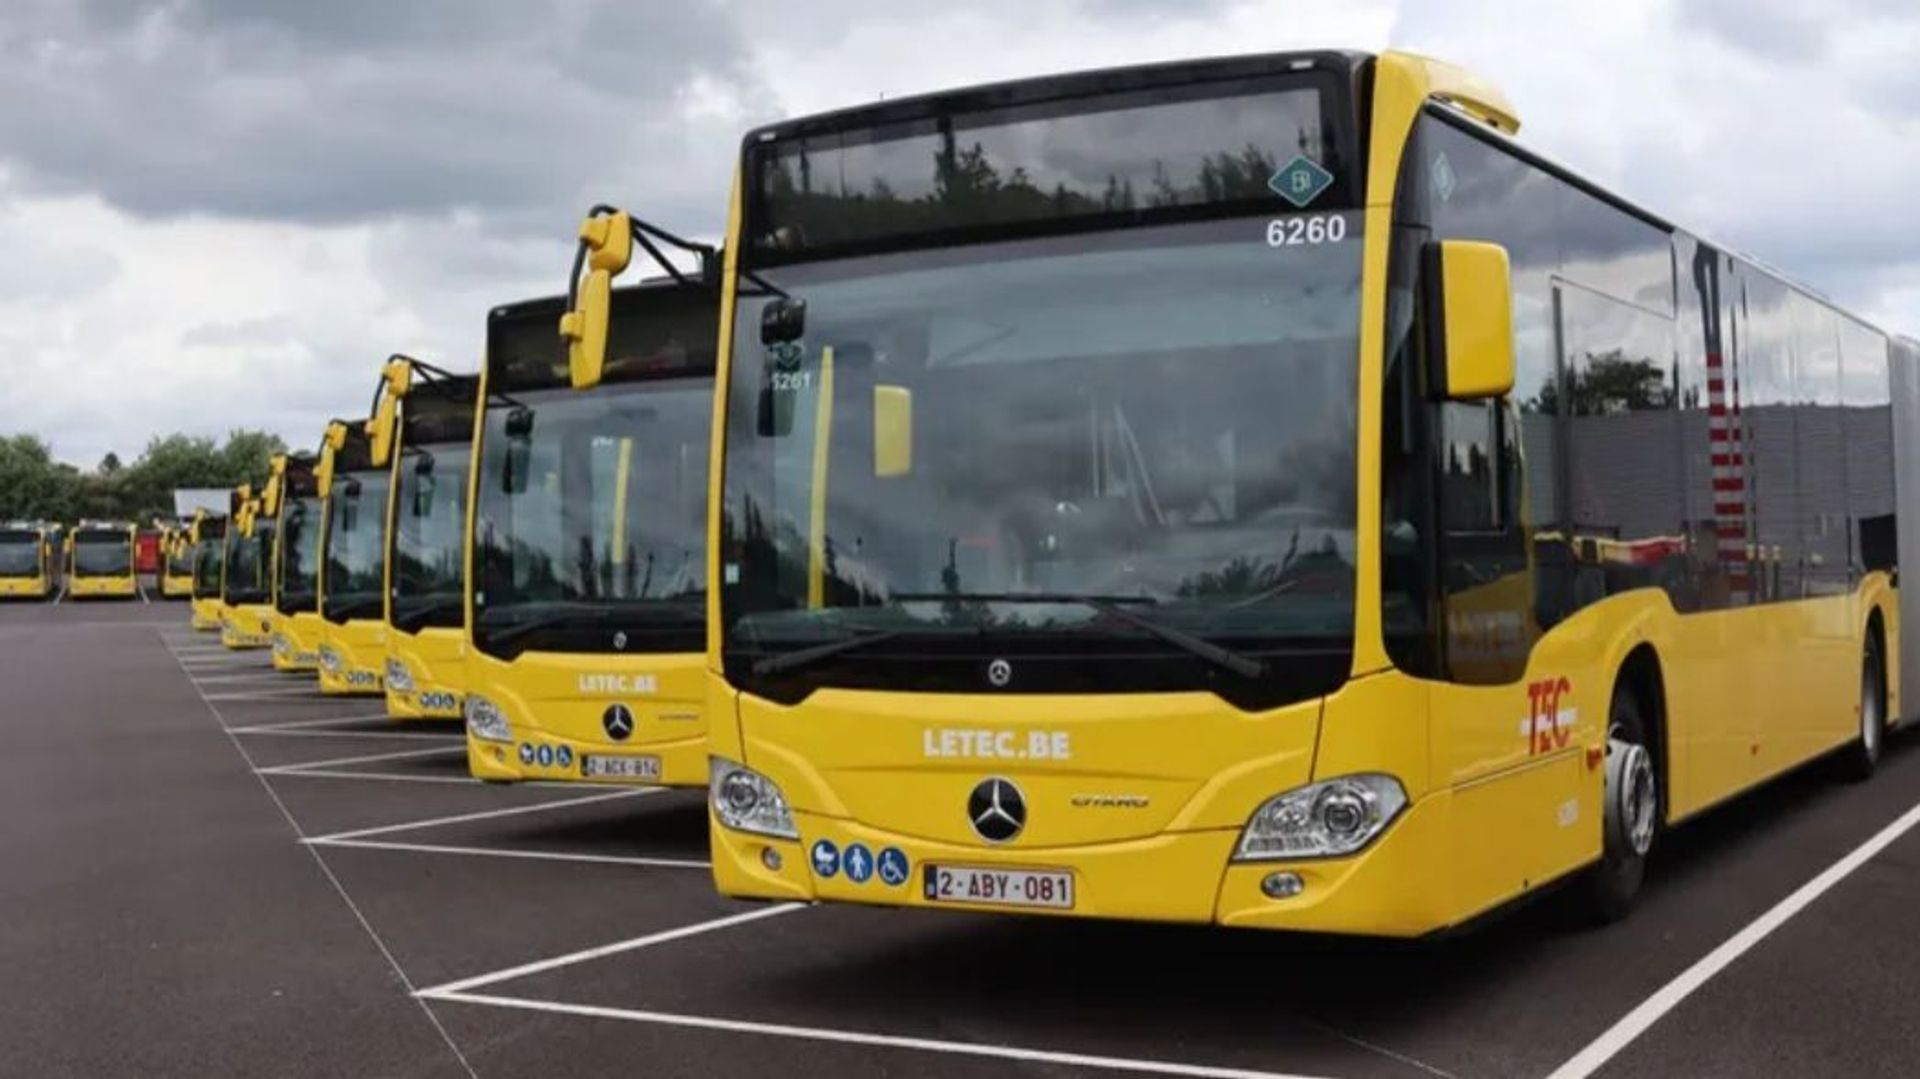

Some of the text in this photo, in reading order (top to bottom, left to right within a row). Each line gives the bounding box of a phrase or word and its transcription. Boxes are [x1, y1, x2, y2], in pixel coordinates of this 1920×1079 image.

[1267, 215, 1346, 246] 6260
[580, 675, 658, 692] LETEC.BE
[1528, 677, 1570, 755] TEC
[924, 731, 1070, 759] LETEC.BE
[940, 871, 1069, 903] 2-ABY-081
